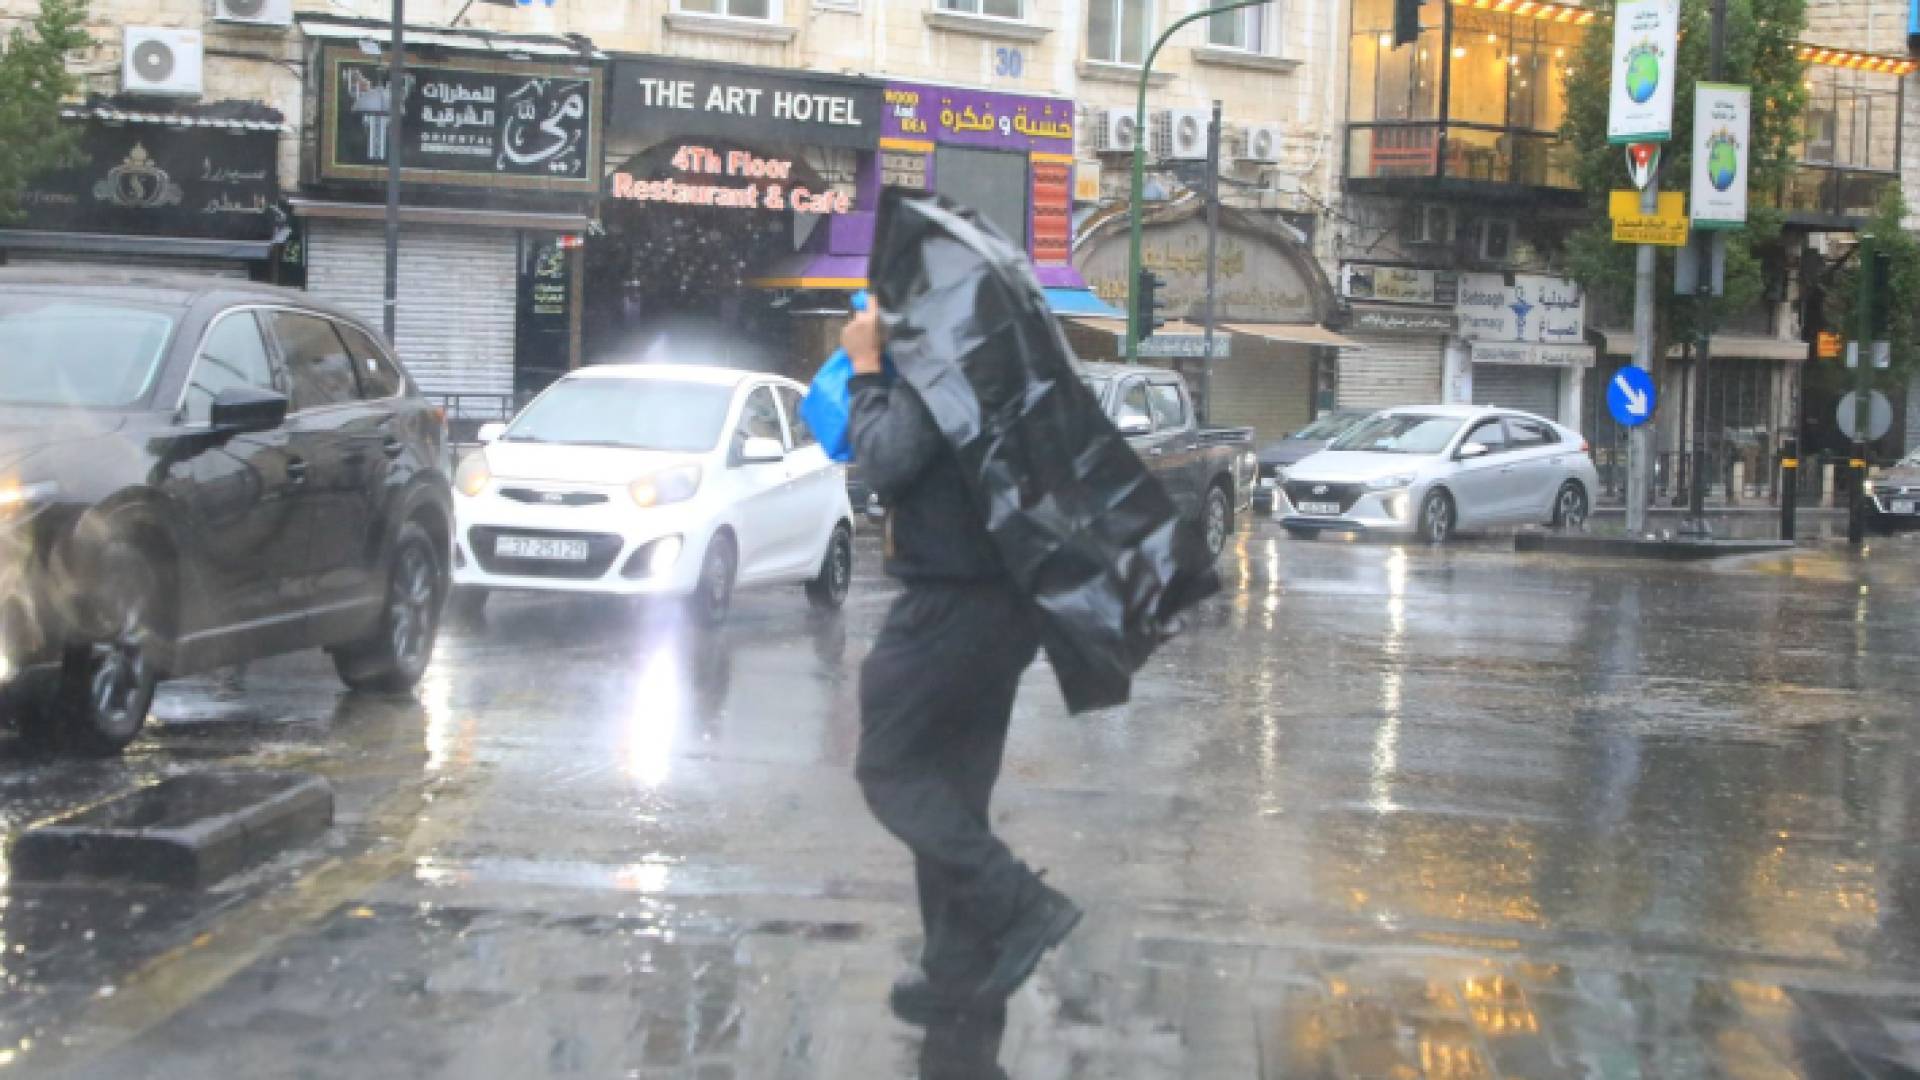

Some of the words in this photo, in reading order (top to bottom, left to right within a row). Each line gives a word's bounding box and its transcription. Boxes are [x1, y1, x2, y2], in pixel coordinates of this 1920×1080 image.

[996, 48, 1023, 77] 30
[639, 77, 695, 109] THE
[704, 83, 763, 117] ART
[772, 90, 863, 126] HOTEL
[939, 98, 995, 134] فكرة
[998, 115, 1011, 136] و
[672, 145, 722, 174] 4Th
[726, 150, 792, 179] Floor
[612, 172, 757, 209] Restaurant
[764, 184, 784, 210] &
